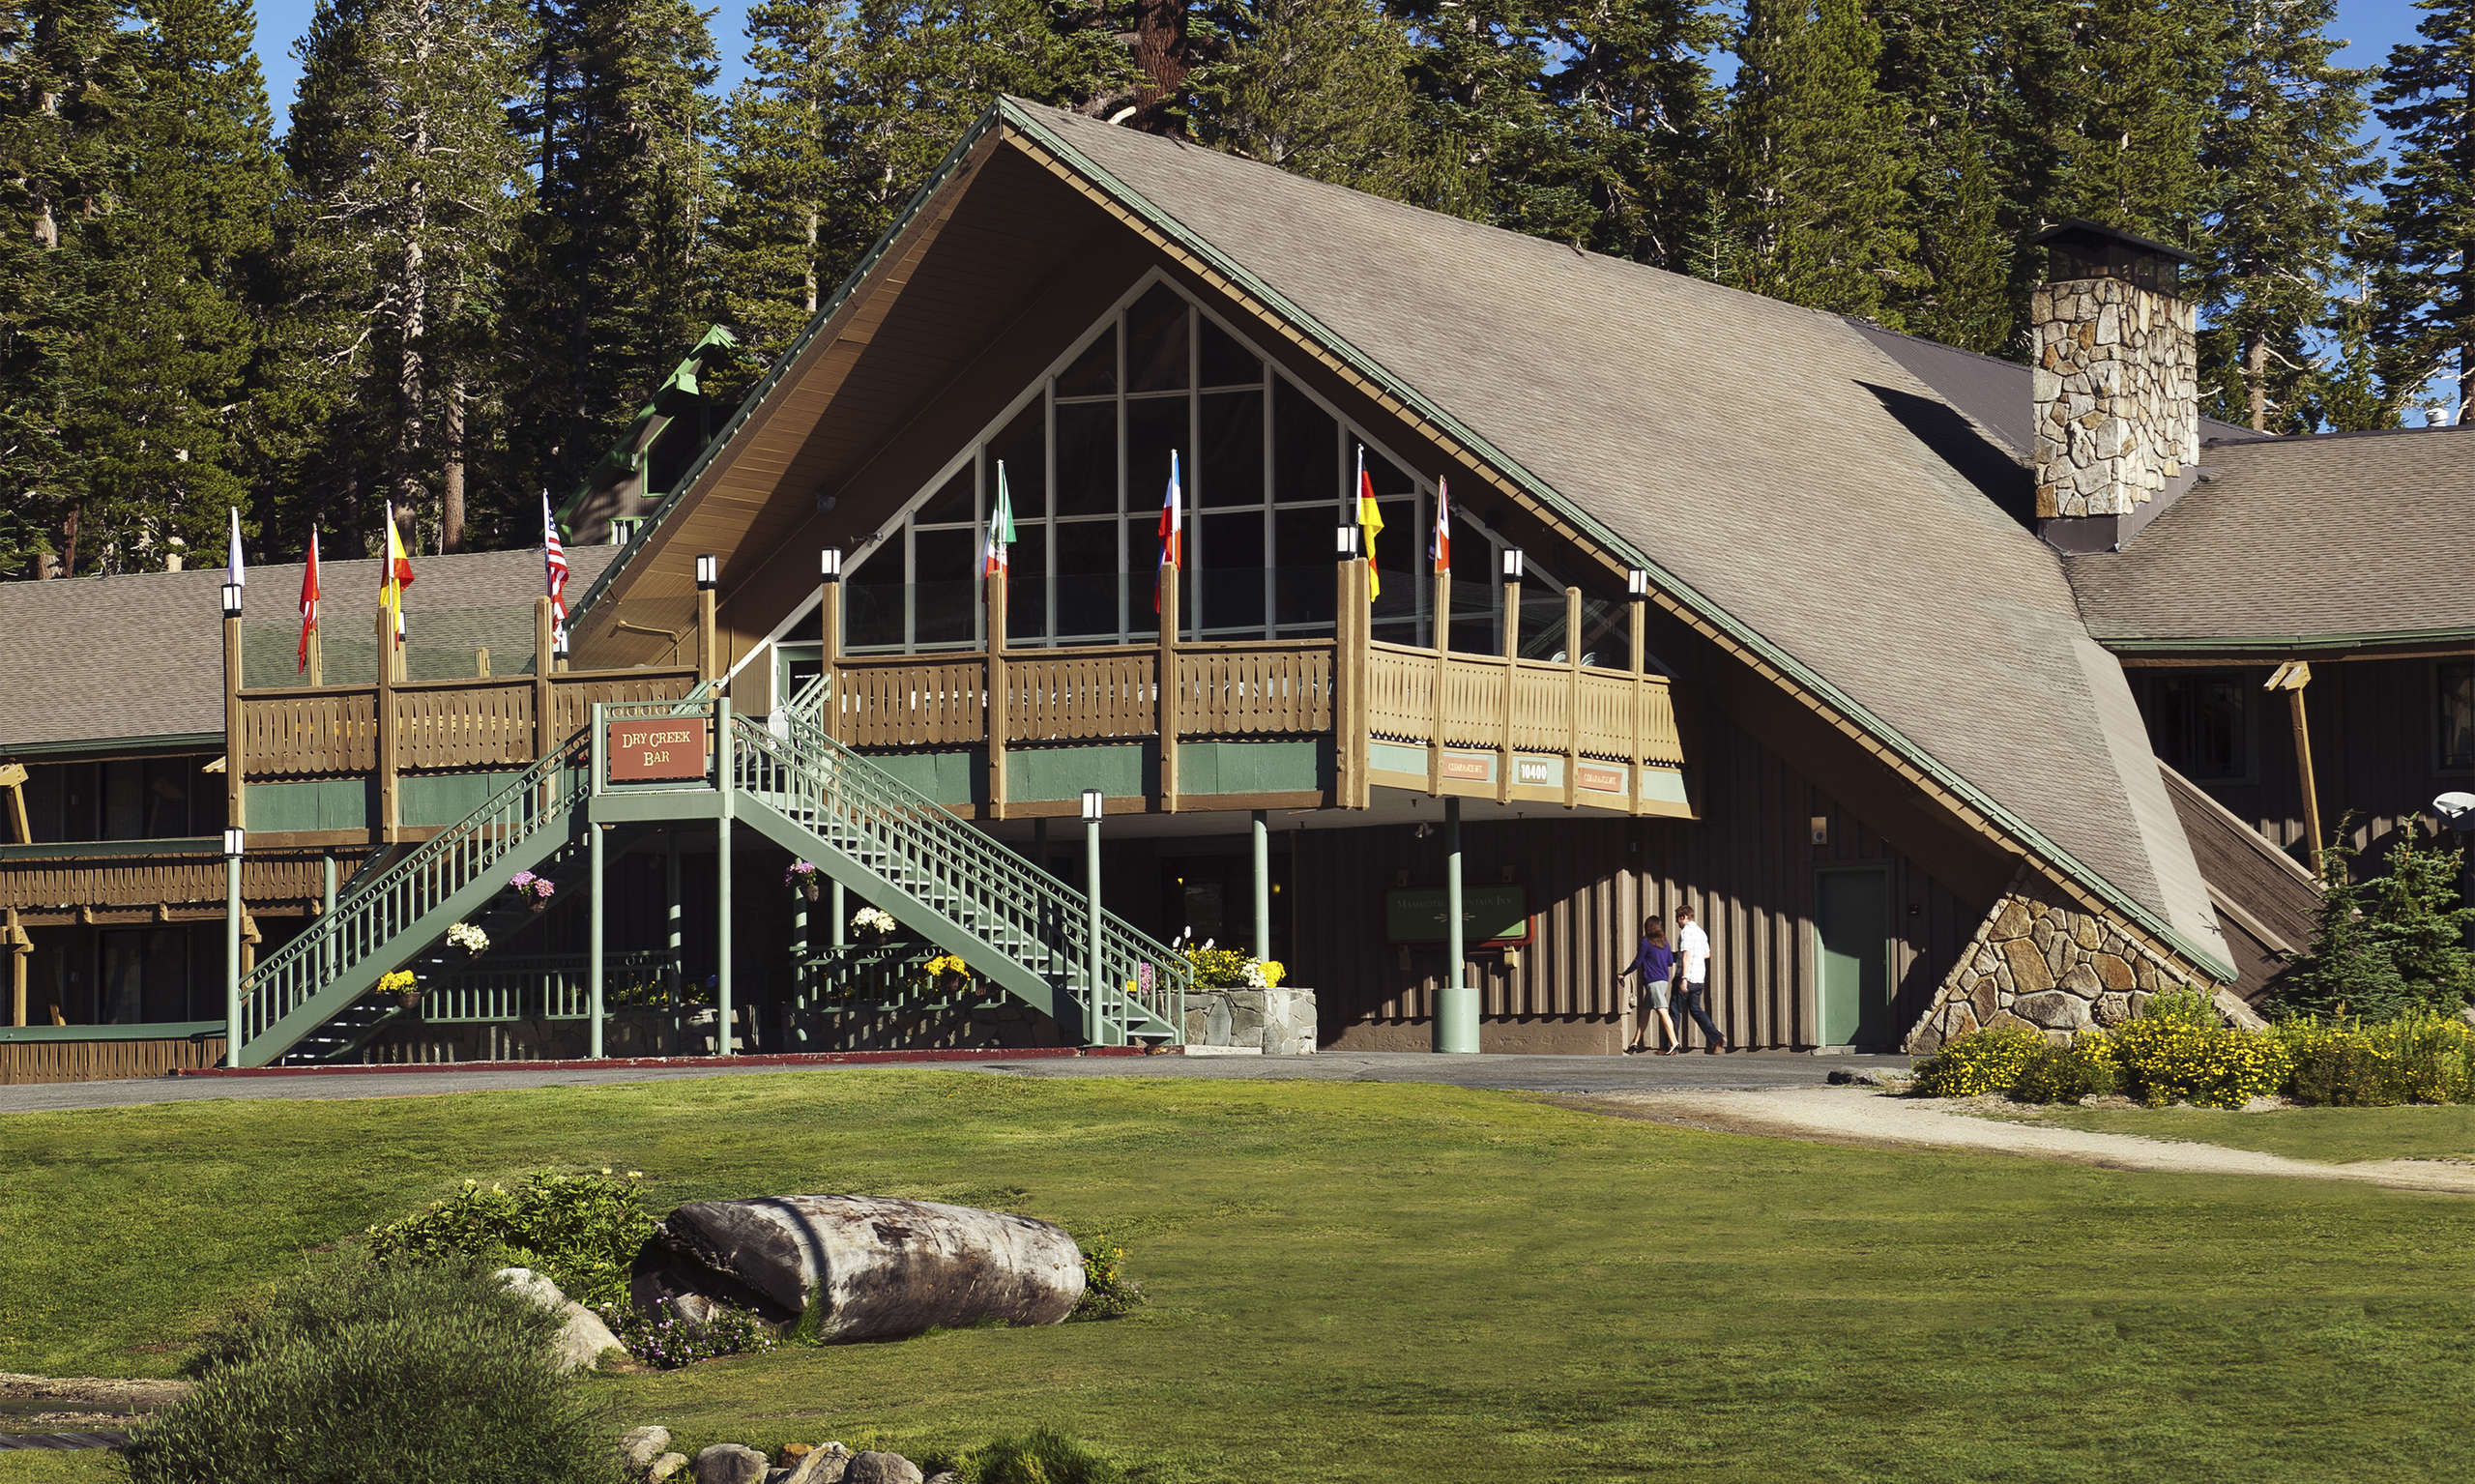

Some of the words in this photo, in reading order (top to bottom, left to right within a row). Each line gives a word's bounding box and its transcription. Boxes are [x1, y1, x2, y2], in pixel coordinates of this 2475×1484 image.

[622, 732, 648, 748] DRY
[650, 731, 691, 747] CREEK
[643, 750, 670, 767] BAR
[1521, 764, 1548, 780] 10400
